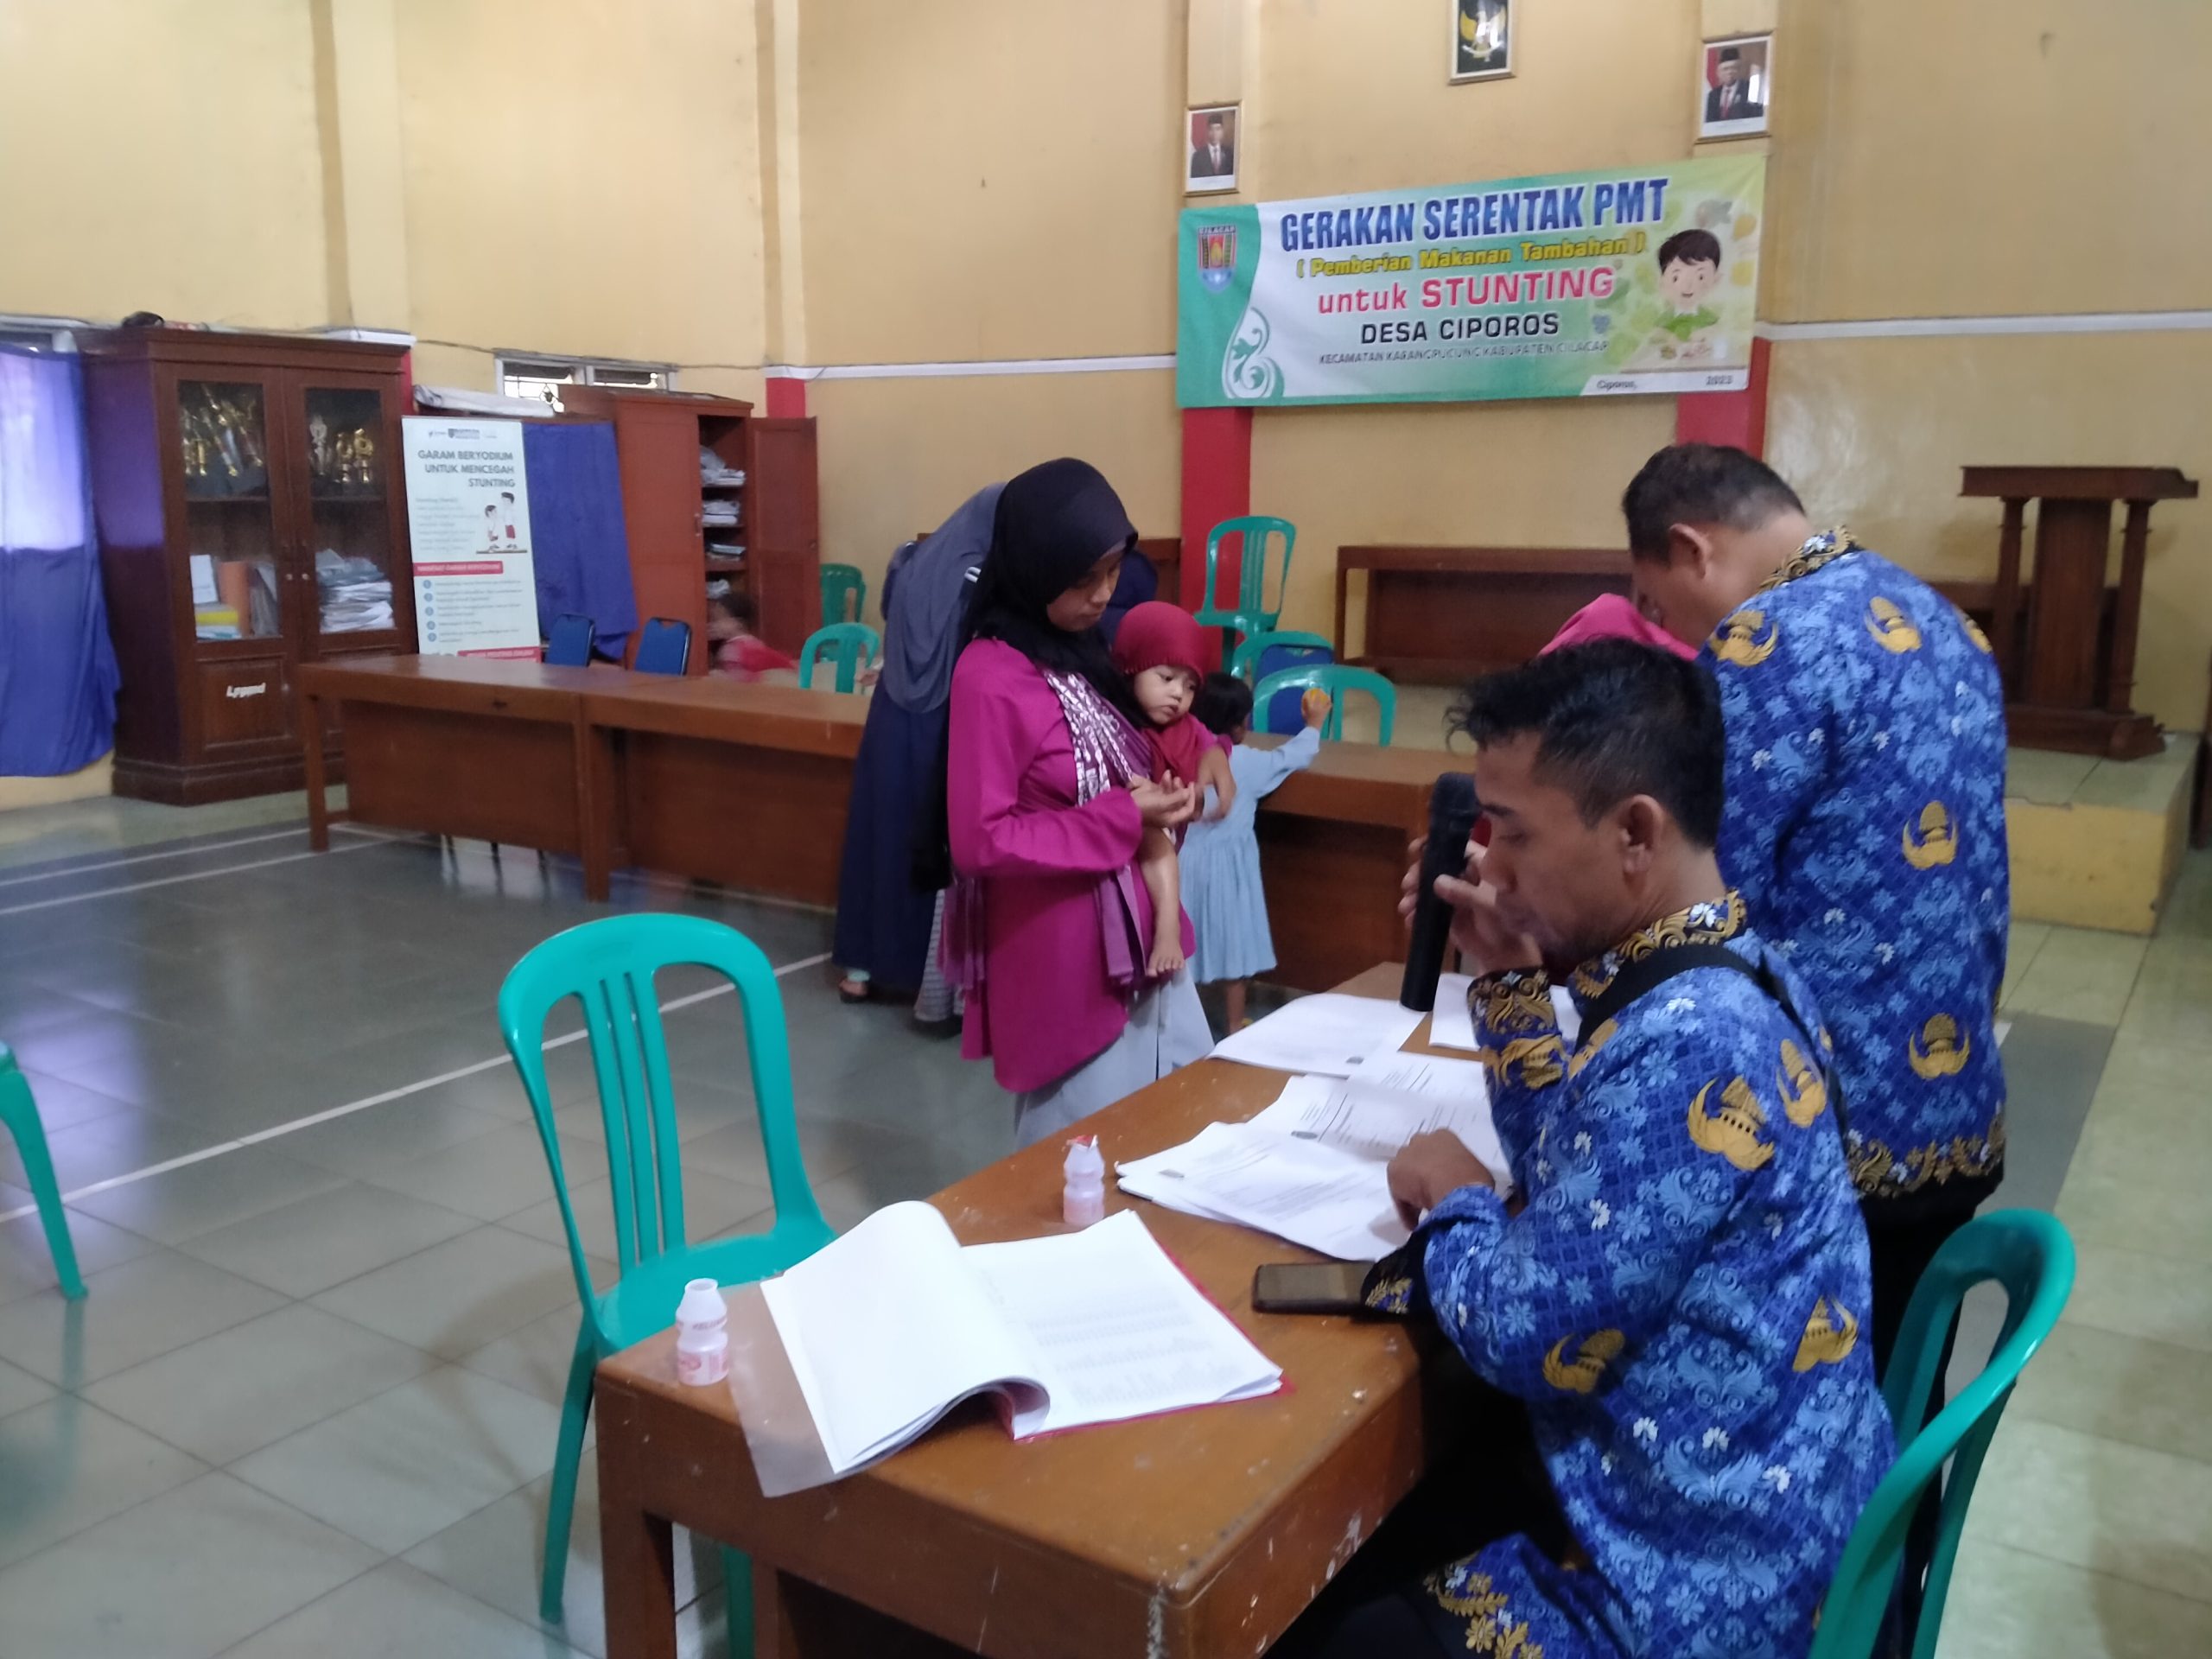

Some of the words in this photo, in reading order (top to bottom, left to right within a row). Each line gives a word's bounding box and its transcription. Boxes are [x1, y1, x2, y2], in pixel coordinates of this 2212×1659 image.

[1281, 203, 1414, 251] GERAKAN
[1423, 186, 1585, 239] SERENTAK
[1594, 178, 1669, 226] PMT
[1419, 247, 1511, 270] Makanan
[1319, 283, 1408, 314] untuk
[1422, 267, 1612, 308] STUNTING
[1362, 321, 1427, 344] DESA
[1440, 313, 1559, 340] CIPOROS
[1319, 352, 1382, 364] KECAMATAN
[417, 450, 455, 460] GARAM
[458, 451, 513, 461] BERYODIUM
[425, 464, 459, 474] UNTUK
[461, 465, 514, 474] MENCEGAH
[468, 478, 516, 487] STUNTING
